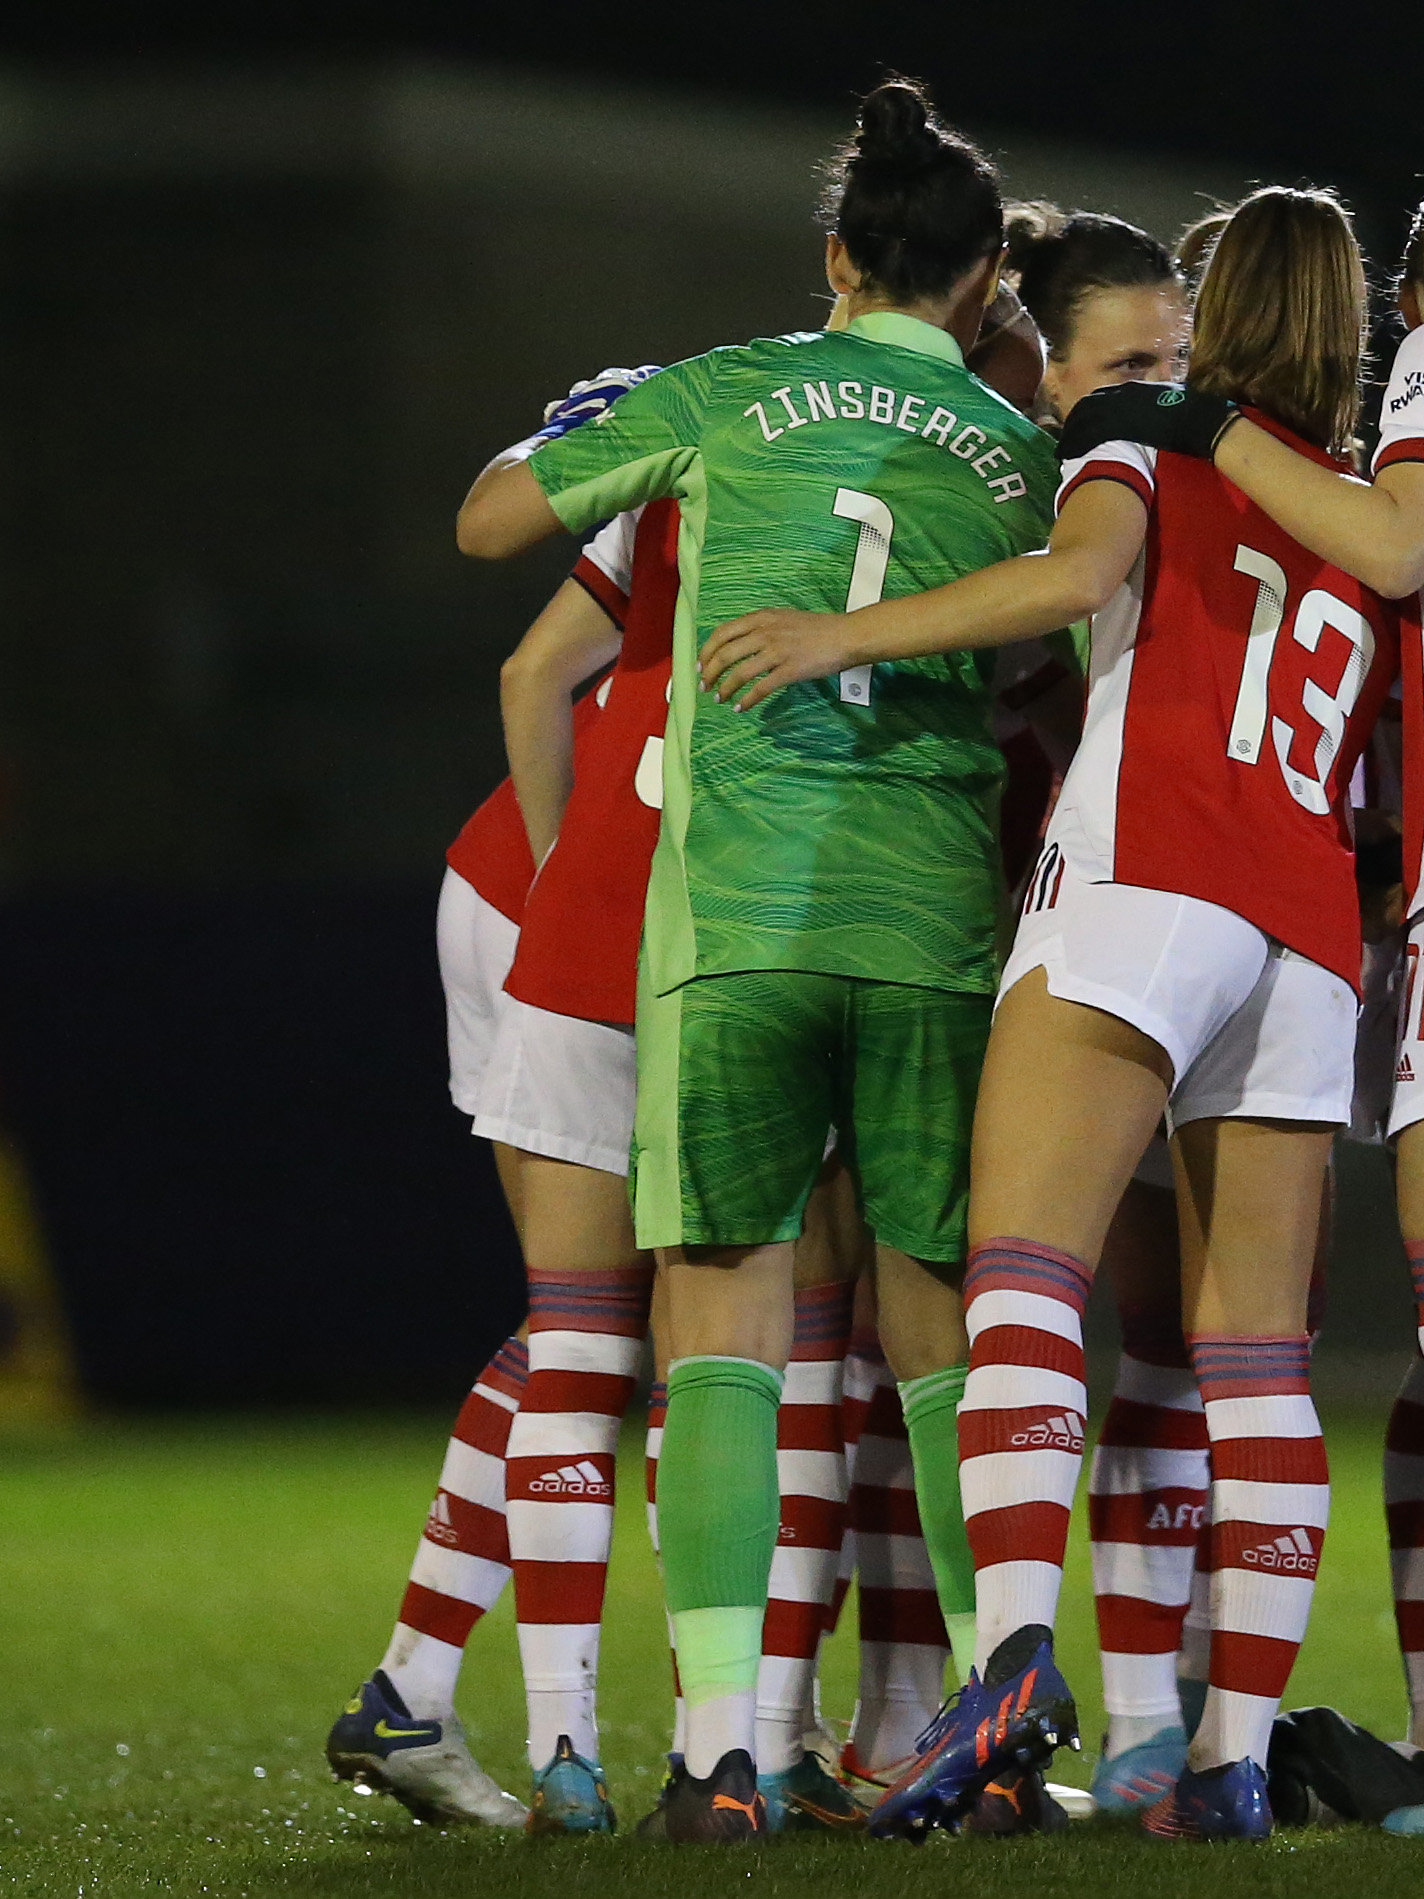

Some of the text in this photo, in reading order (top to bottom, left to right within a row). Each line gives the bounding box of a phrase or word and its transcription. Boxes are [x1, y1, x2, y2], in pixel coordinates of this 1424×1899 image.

[743, 381, 1028, 504] ZINSBERGER
[832, 487, 895, 706] 1
[1227, 544, 1376, 815] 13
[1011, 1430, 1085, 1450] adida
[528, 1479, 612, 1496] adidas
[1242, 1549, 1318, 1572] adidas
